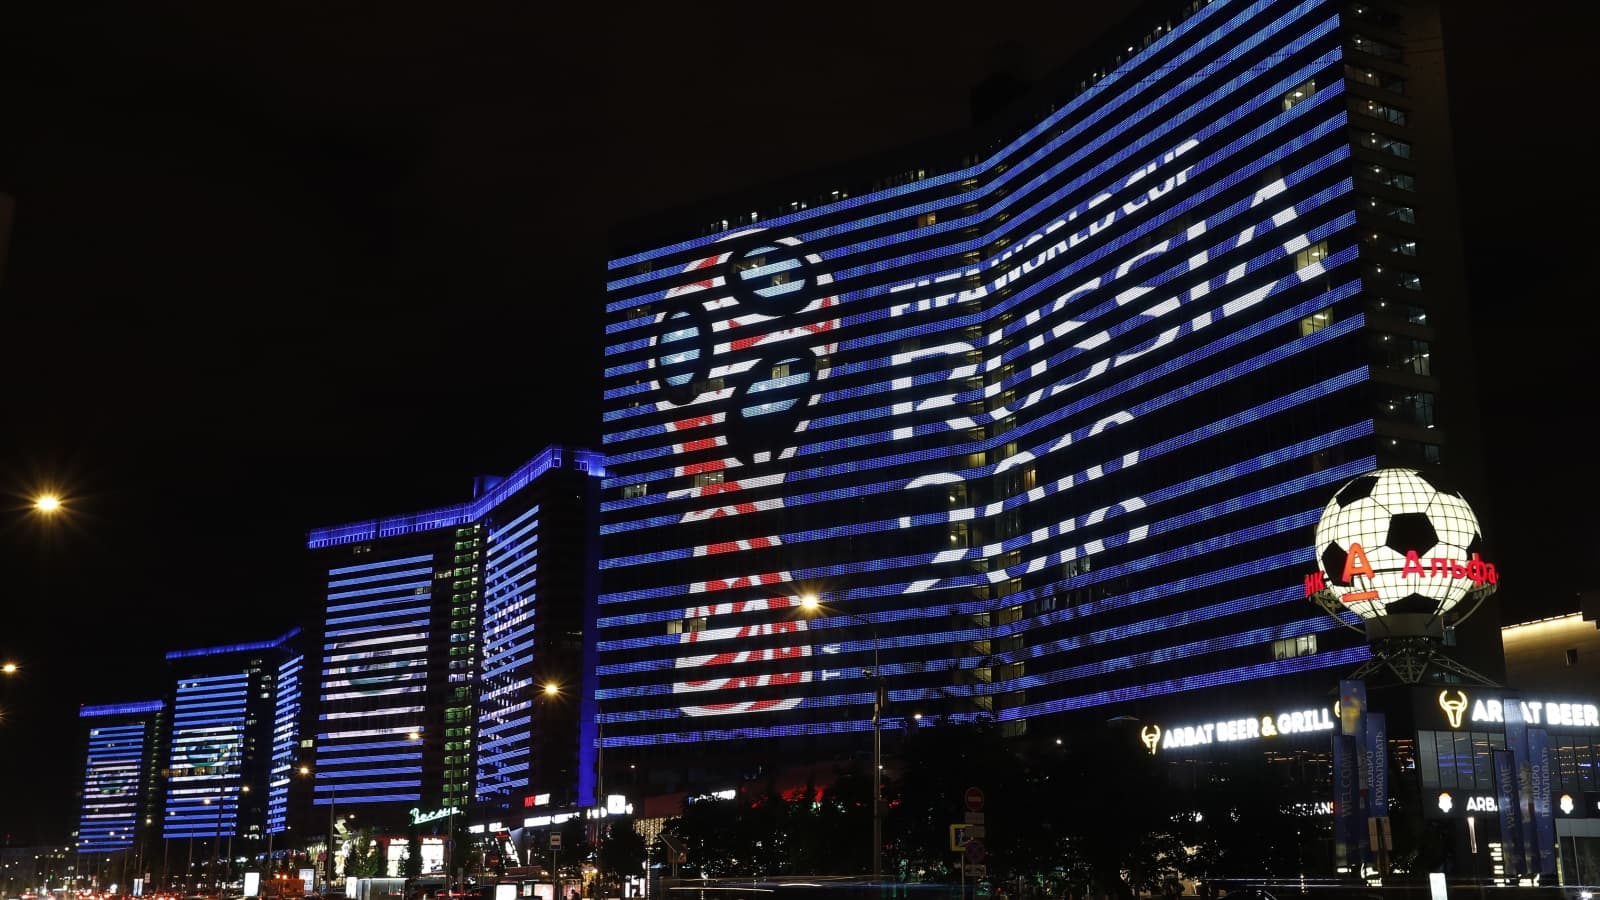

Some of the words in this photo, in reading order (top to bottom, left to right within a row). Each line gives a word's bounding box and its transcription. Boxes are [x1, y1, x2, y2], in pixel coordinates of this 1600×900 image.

[890, 267, 988, 317] FIFA
[989, 191, 1119, 291] WORLD
[1122, 138, 1200, 212] CUP
[891, 177, 1327, 442] RUSSIA
[899, 409, 1150, 595] 2018
[1401, 550, 1497, 586] Альфа
[1162, 723, 1215, 750] ARBAT
[1216, 717, 1260, 742] BEER
[1261, 715, 1279, 737] &
[1278, 708, 1334, 734] GRILL
[1472, 698, 1543, 725] ARAT
[1546, 702, 1600, 728] BEER
[1466, 796, 1498, 812] ARB
